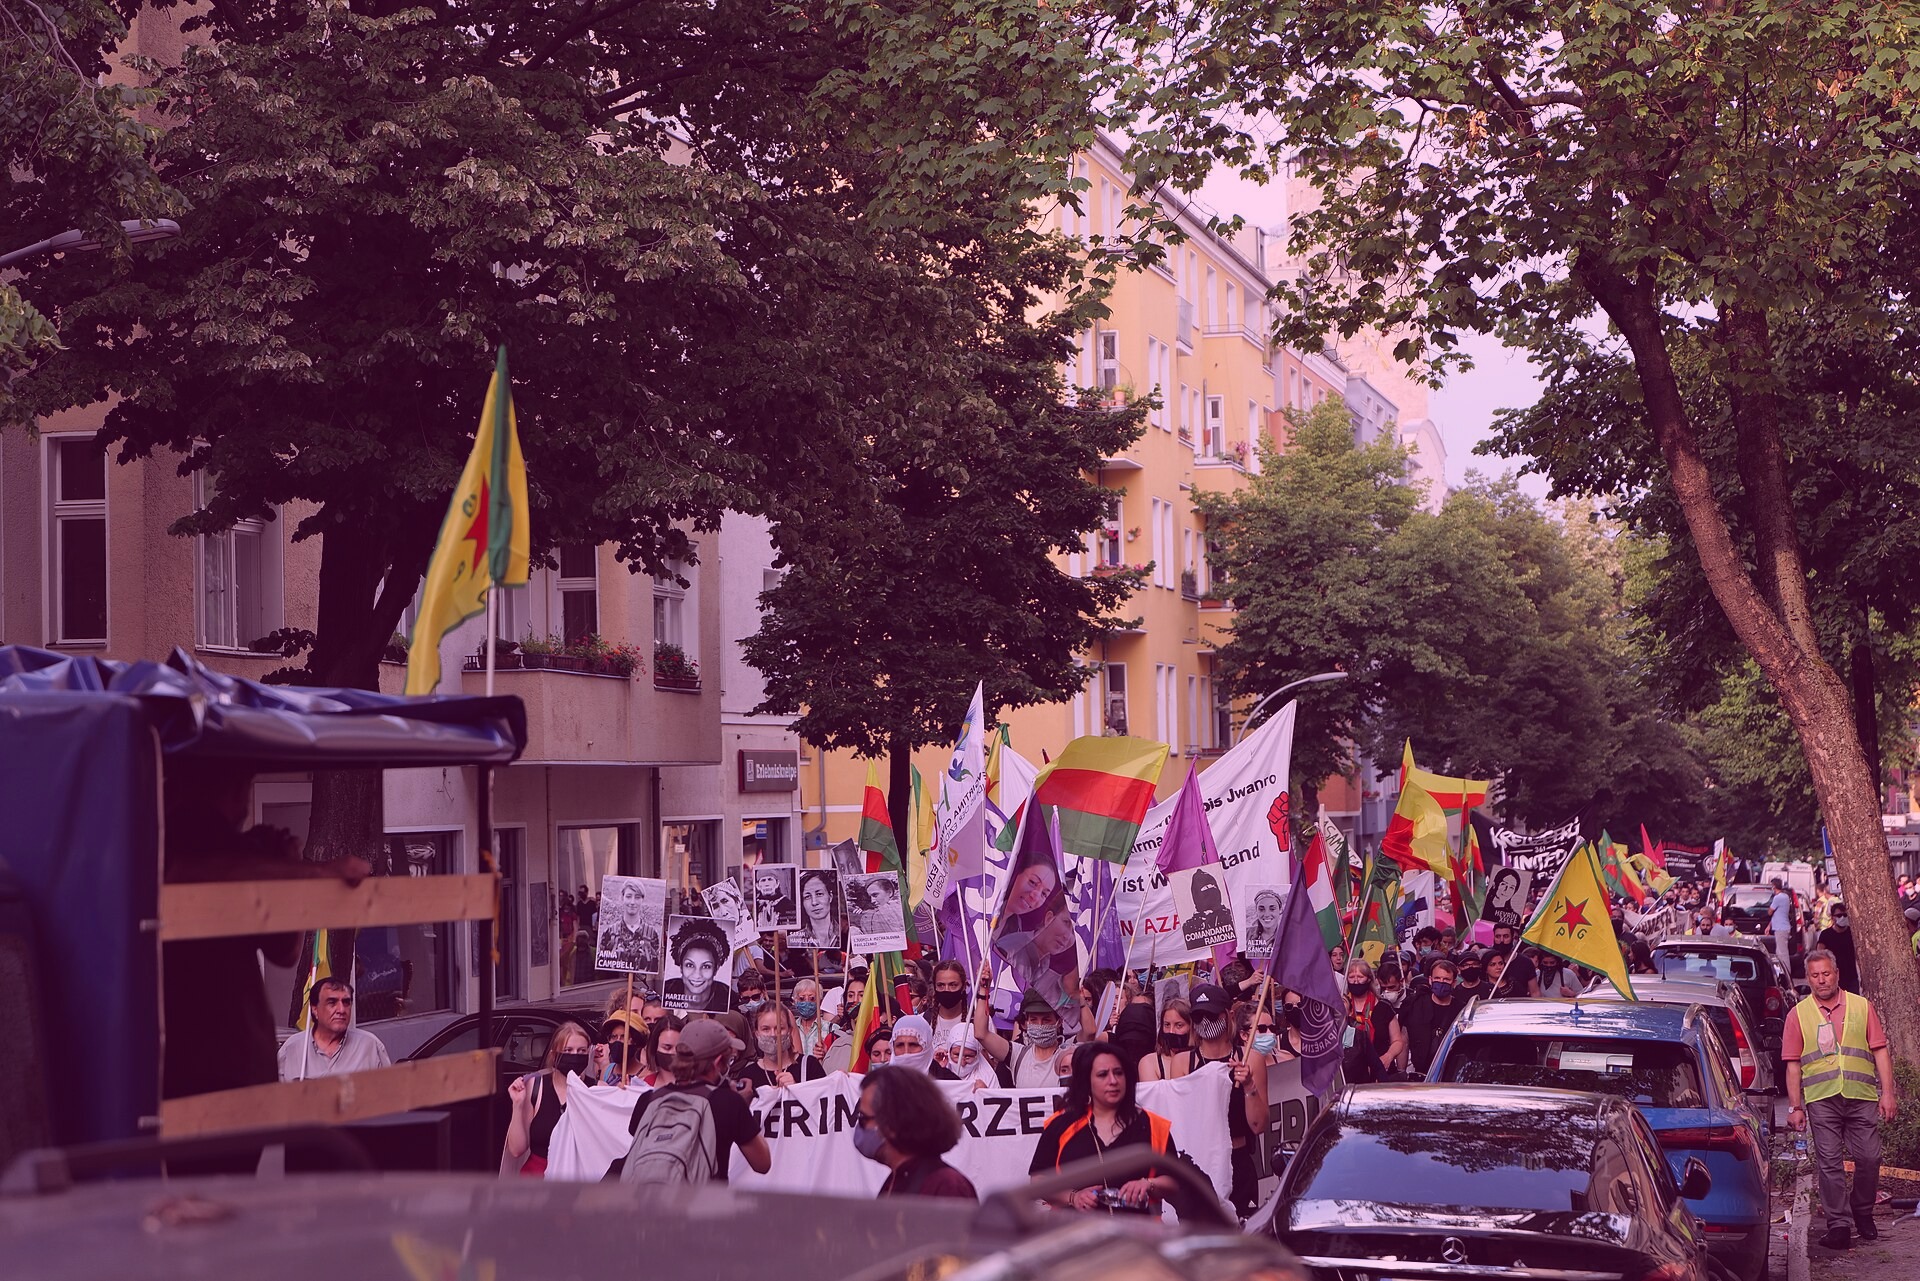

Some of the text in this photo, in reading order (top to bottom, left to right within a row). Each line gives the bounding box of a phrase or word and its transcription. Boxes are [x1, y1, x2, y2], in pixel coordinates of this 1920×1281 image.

[1226, 774, 1277, 803] Jwanro
[1122, 875, 1145, 893] ist
[1185, 923, 1235, 943] COMANDANTA
[1204, 931, 1236, 946] RAMONA
[599, 950, 618, 959] ANNA
[598, 959, 635, 970] CAMPBELL
[665, 992, 698, 1002] MARIELLE
[664, 1000, 689, 1009] FRANCO
